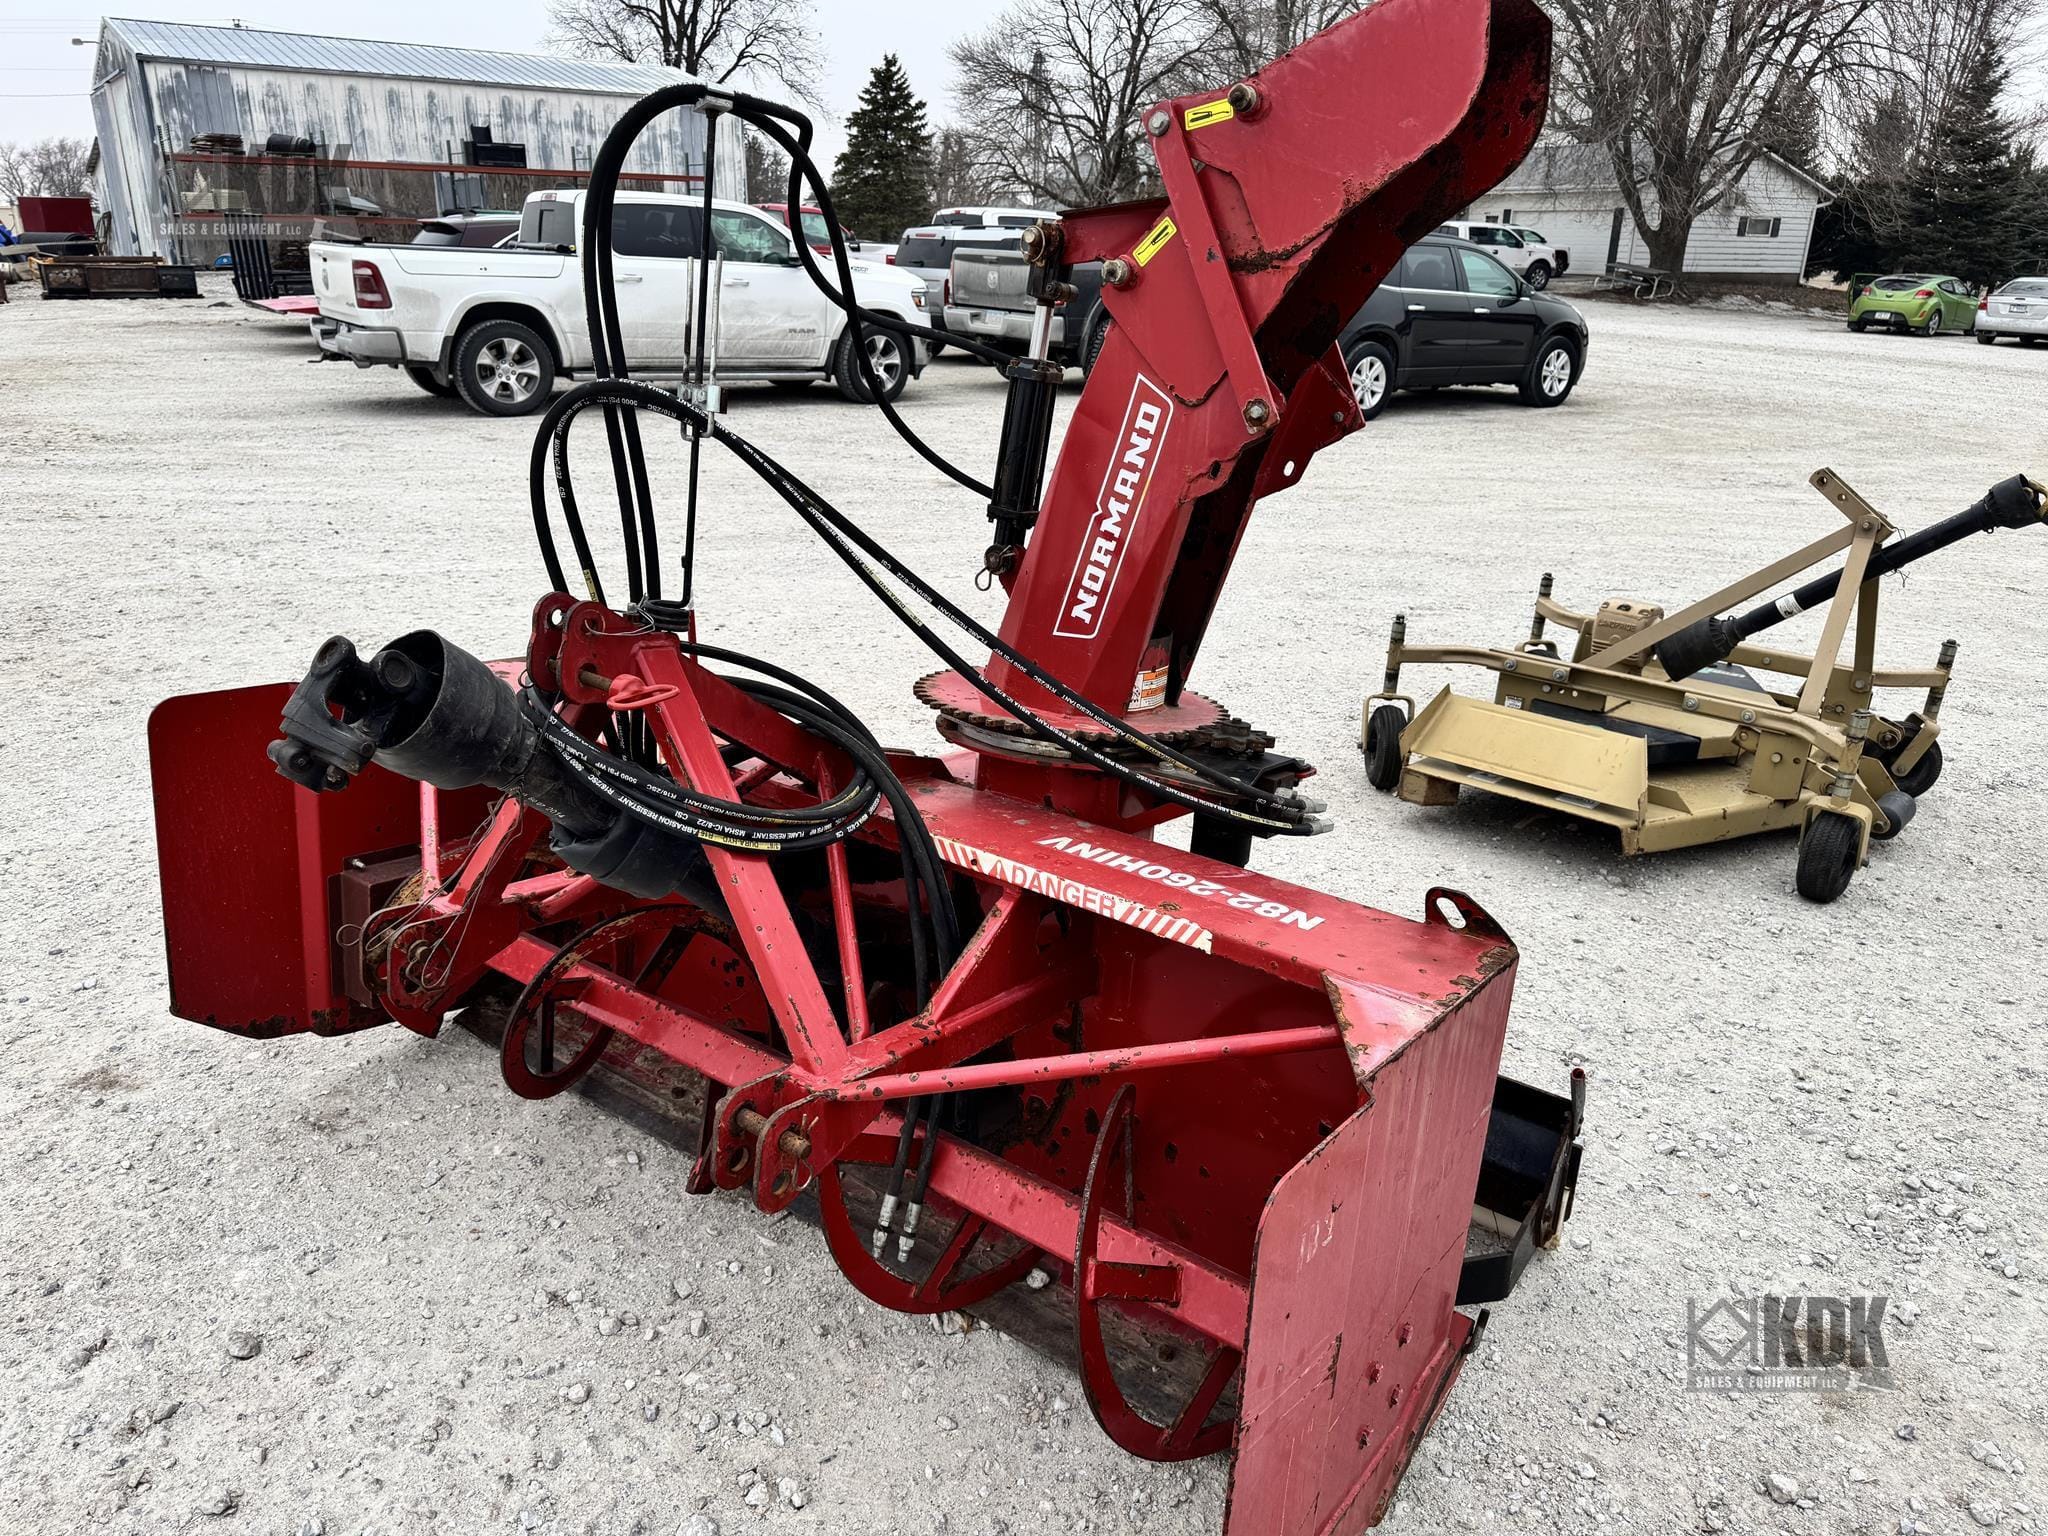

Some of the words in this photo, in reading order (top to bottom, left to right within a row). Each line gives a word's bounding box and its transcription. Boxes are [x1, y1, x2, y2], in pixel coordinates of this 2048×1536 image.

[1071, 401, 1162, 625] NORMAND
[879, 558, 892, 569] CSI
[1060, 693, 1094, 717] RESISTANT
[548, 714, 558, 725] CS
[1065, 734, 1088, 752] FLAME
[564, 744, 589, 762] FLAME
[568, 756, 585, 773] 5000
[593, 760, 607, 770] WP
[606, 766, 620, 776] PSI
[619, 771, 638, 785] 5000
[645, 782, 677, 800] R16/2SC
[616, 793, 659, 820] RESISTANT
[682, 797, 725, 813] RESISTANT
[673, 809, 689, 821] CSI
[657, 814, 698, 835] ABRASION
[695, 817, 723, 831] IC-8/22
[723, 825, 746, 837] MSHA
[721, 835, 759, 848] DURA-HYD
[751, 831, 786, 839] RESISTANT
[786, 830, 805, 838] FLAME
[1012, 864, 1118, 918] DANGER
[1037, 836, 1325, 931] N82-260HINV
